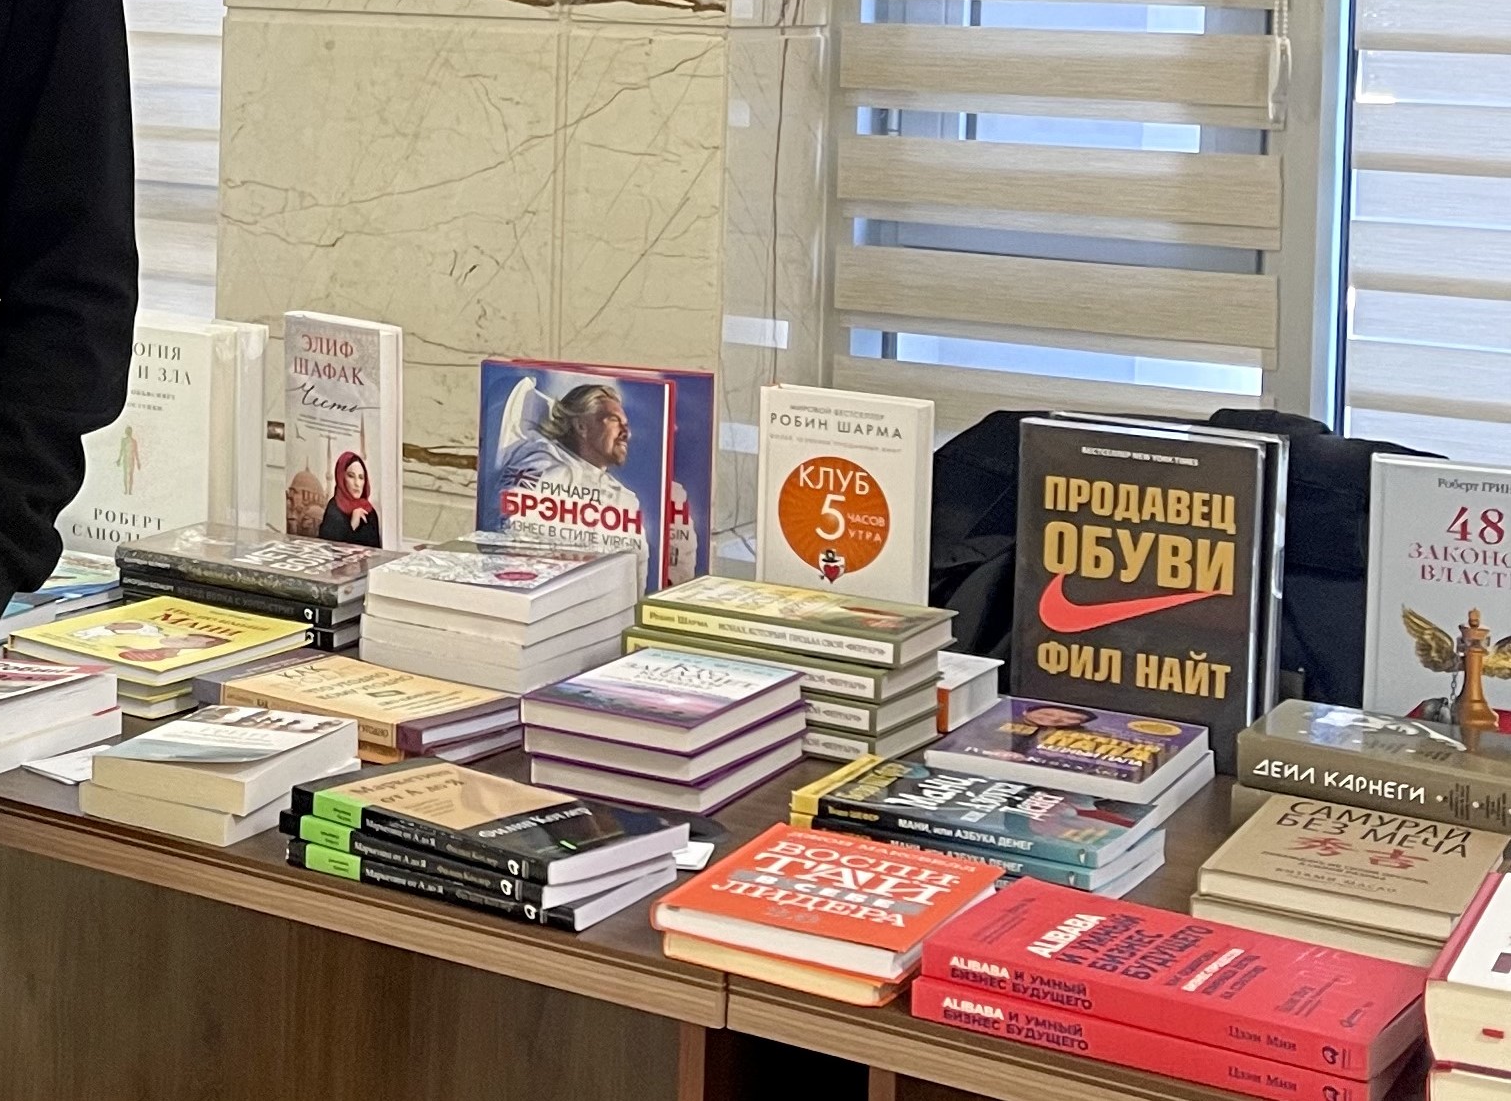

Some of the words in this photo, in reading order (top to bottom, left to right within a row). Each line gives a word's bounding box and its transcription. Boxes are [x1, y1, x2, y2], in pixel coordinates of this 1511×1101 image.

[301, 333, 354, 359] ЭЛИФ
[293, 356, 365, 386] ШАФАК
[289, 382, 370, 413] Честь
[770, 412, 828, 431] РОБИН
[837, 420, 903, 440] ШАРМА
[540, 481, 602, 505] РИЧАРД
[799, 464, 870, 496] КЛУБ
[1438, 478, 1479, 493] Роберт
[1481, 481, 1511, 494] ГРИ
[93, 507, 165, 531] РОБЕРТ
[500, 490, 644, 535] БРЭНСОН
[815, 493, 847, 541] 5
[847, 511, 886, 527] ЧАСОВ
[1043, 475, 1237, 535] ПРОДАВЕЦ
[1446, 506, 1505, 545] 48
[500, 519, 545, 537] БИЗНЕС
[548, 526, 557, 537] В
[560, 528, 598, 543] СТИЛЕ
[602, 533, 642, 551] VIRGIN
[847, 528, 883, 544] УТРА
[1043, 520, 1235, 596] ОБУВИ
[1420, 564, 1511, 589] ВЛАСТ
[1036, 640, 1123, 685] ФИЛ
[1135, 650, 1232, 699] НАЙТ
[1041, 736, 1152, 764] ПАПА
[1324, 770, 1425, 805] КАРНЕГИ
[933, 826, 954, 837] или
[954, 829, 997, 846] АЗБУКА
[997, 836, 1035, 851] ДЕНЕГ
[1275, 812, 1349, 836] БЕЗ
[1360, 828, 1467, 858] МЕЧА
[1289, 801, 1472, 844] САМУРАЙ
[753, 852, 951, 906] ТАЙ
[767, 840, 961, 885] ВОСПИ-
[711, 879, 906, 928] ЛИДЕРА
[755, 874, 779, 886] В
[793, 881, 896, 908] СЕБЕ
[1026, 912, 1107, 959] ALIBABA
[1088, 929, 1164, 974] БИЗНЕС
[1120, 925, 1215, 981] БУДУЩЕГО
[949, 955, 1011, 980] ALIBABA
[1014, 970, 1025, 982] И
[1031, 972, 1087, 997] УМНЫЙ
[950, 967, 1007, 991] БИЗНЕС
[1011, 981, 1093, 1011] БУДУЩЕГО
[942, 996, 1005, 1021] ALIBABA
[1008, 1010, 1020, 1023] И
[1025, 1013, 1084, 1038] УМНЫЙ
[942, 1008, 1001, 1031] БИЗНЕС
[1006, 1023, 1089, 1052] БУДУЩЕГО
